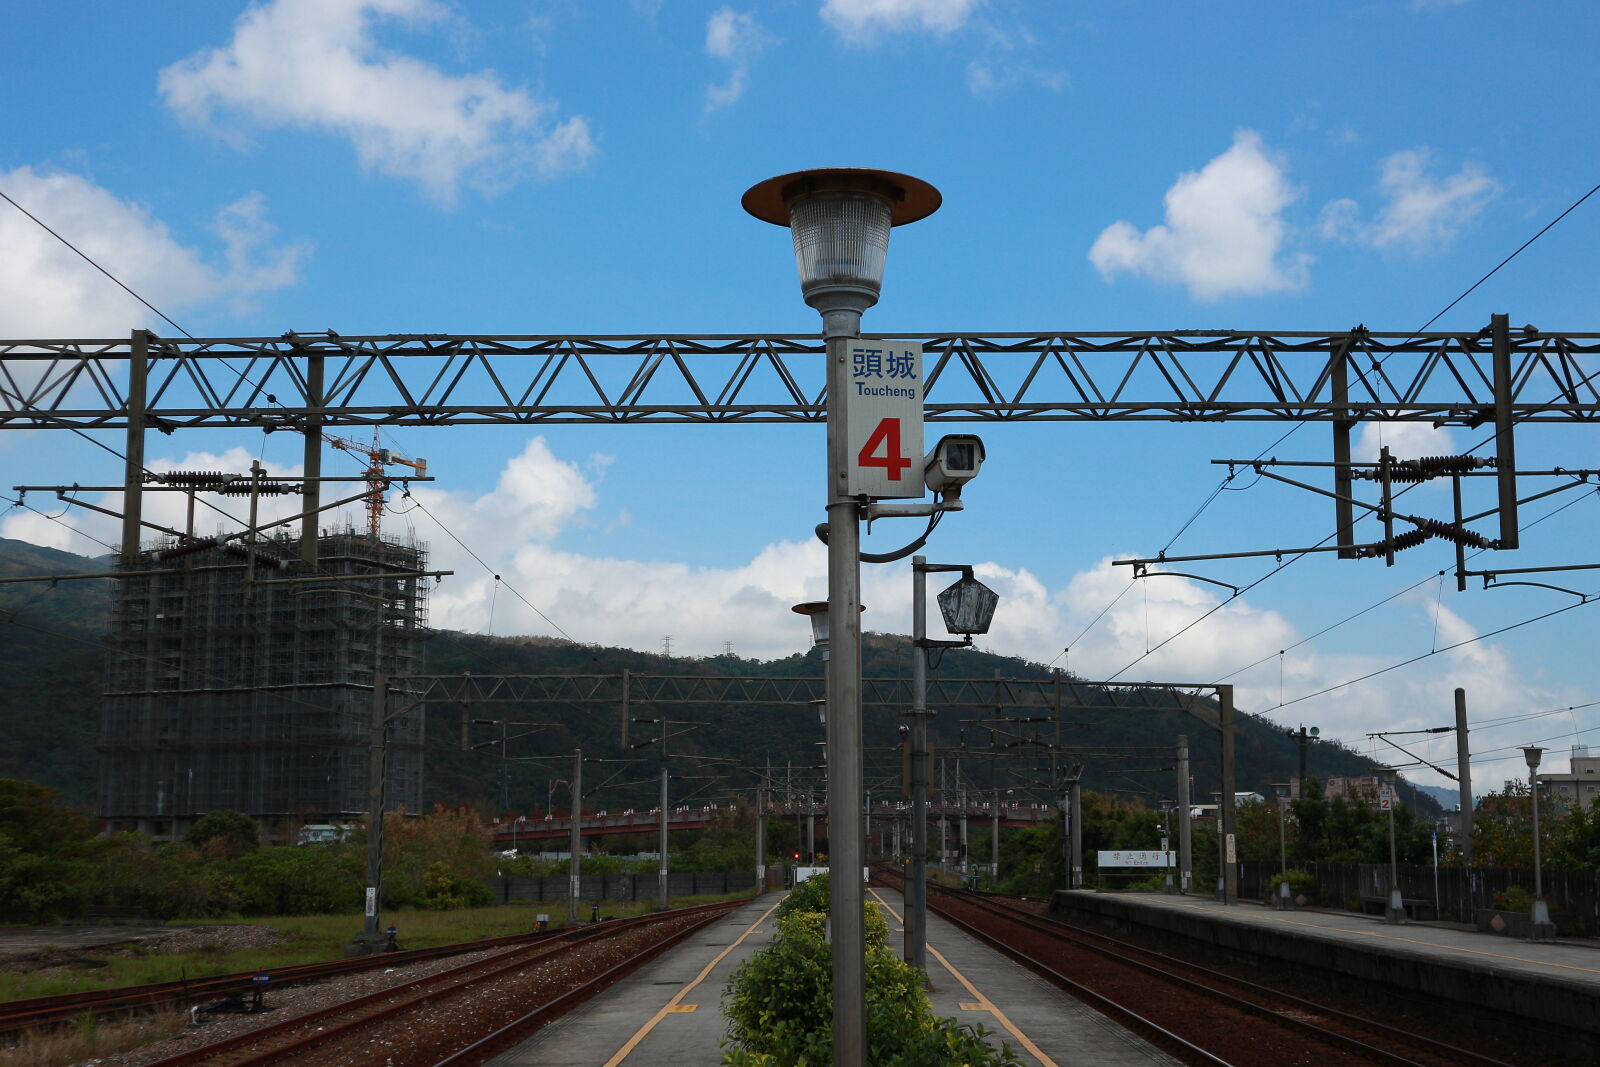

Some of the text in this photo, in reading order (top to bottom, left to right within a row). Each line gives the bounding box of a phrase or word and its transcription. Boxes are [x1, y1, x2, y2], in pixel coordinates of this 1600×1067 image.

[853, 348, 917, 380] 頭城
[855, 381, 915, 400] Toucheng
[858, 417, 912, 481] 4
[1382, 799, 1390, 809] 2
